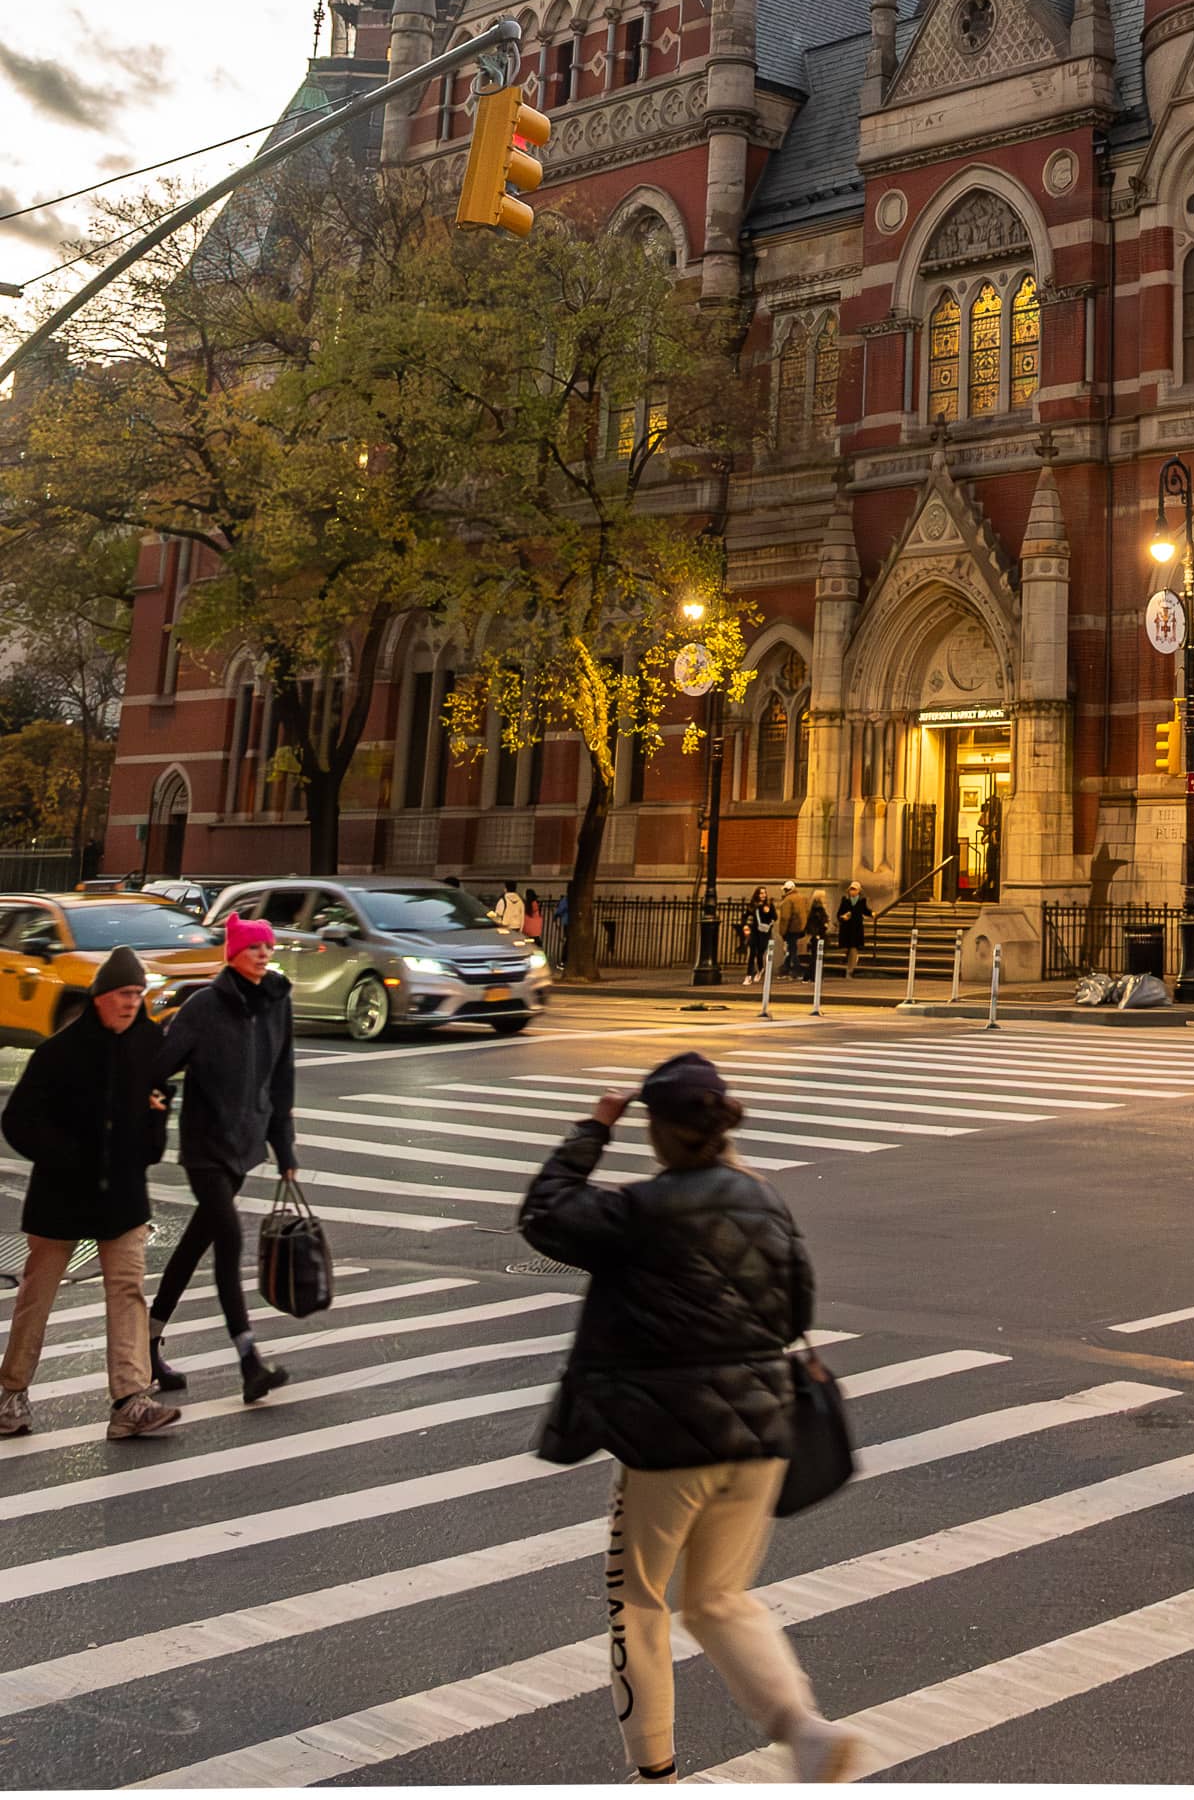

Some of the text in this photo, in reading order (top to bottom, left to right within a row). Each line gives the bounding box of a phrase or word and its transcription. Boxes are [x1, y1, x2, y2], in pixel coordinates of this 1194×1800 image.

[918, 708, 1005, 721] JEFFERSON MARKET BRANCH
